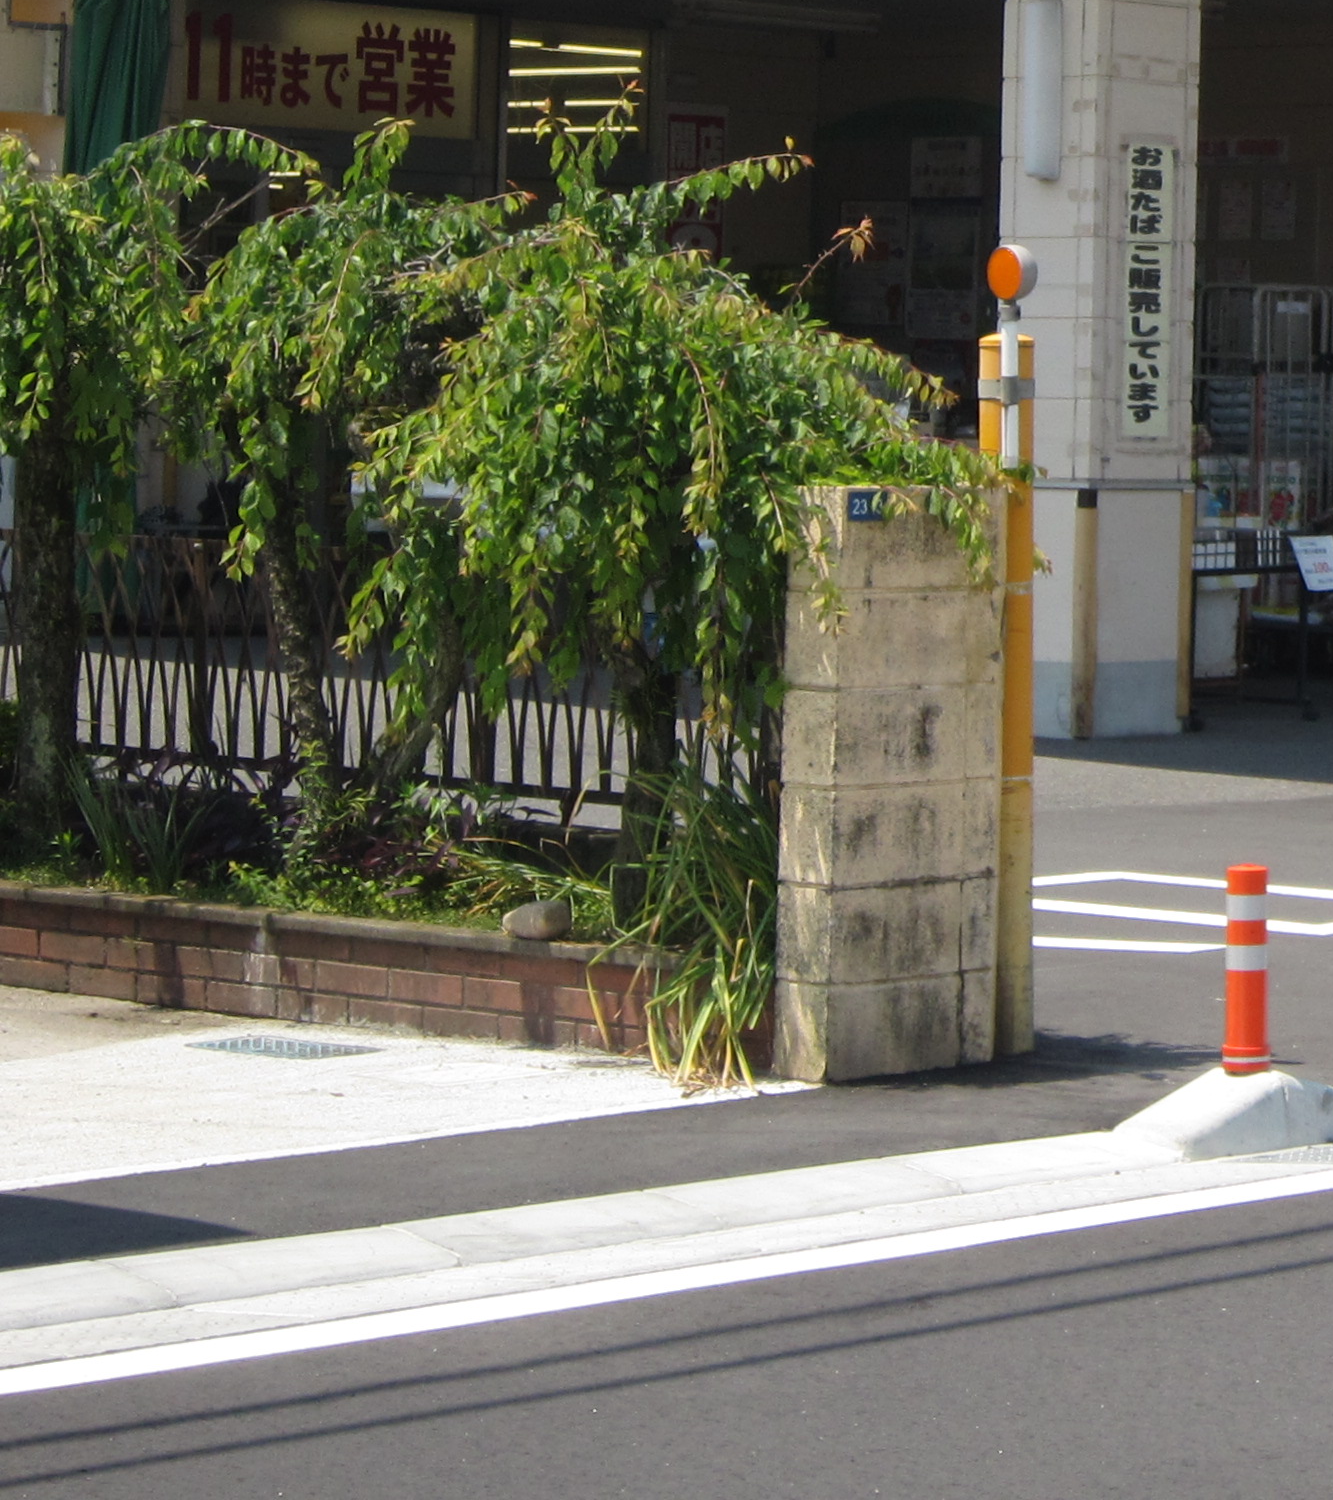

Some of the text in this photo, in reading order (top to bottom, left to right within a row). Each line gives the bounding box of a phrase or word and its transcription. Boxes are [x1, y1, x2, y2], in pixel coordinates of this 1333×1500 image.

[185, 10, 456, 118] 11時まで営業
[1127, 145, 1164, 423] お酒たばこ販売しています
